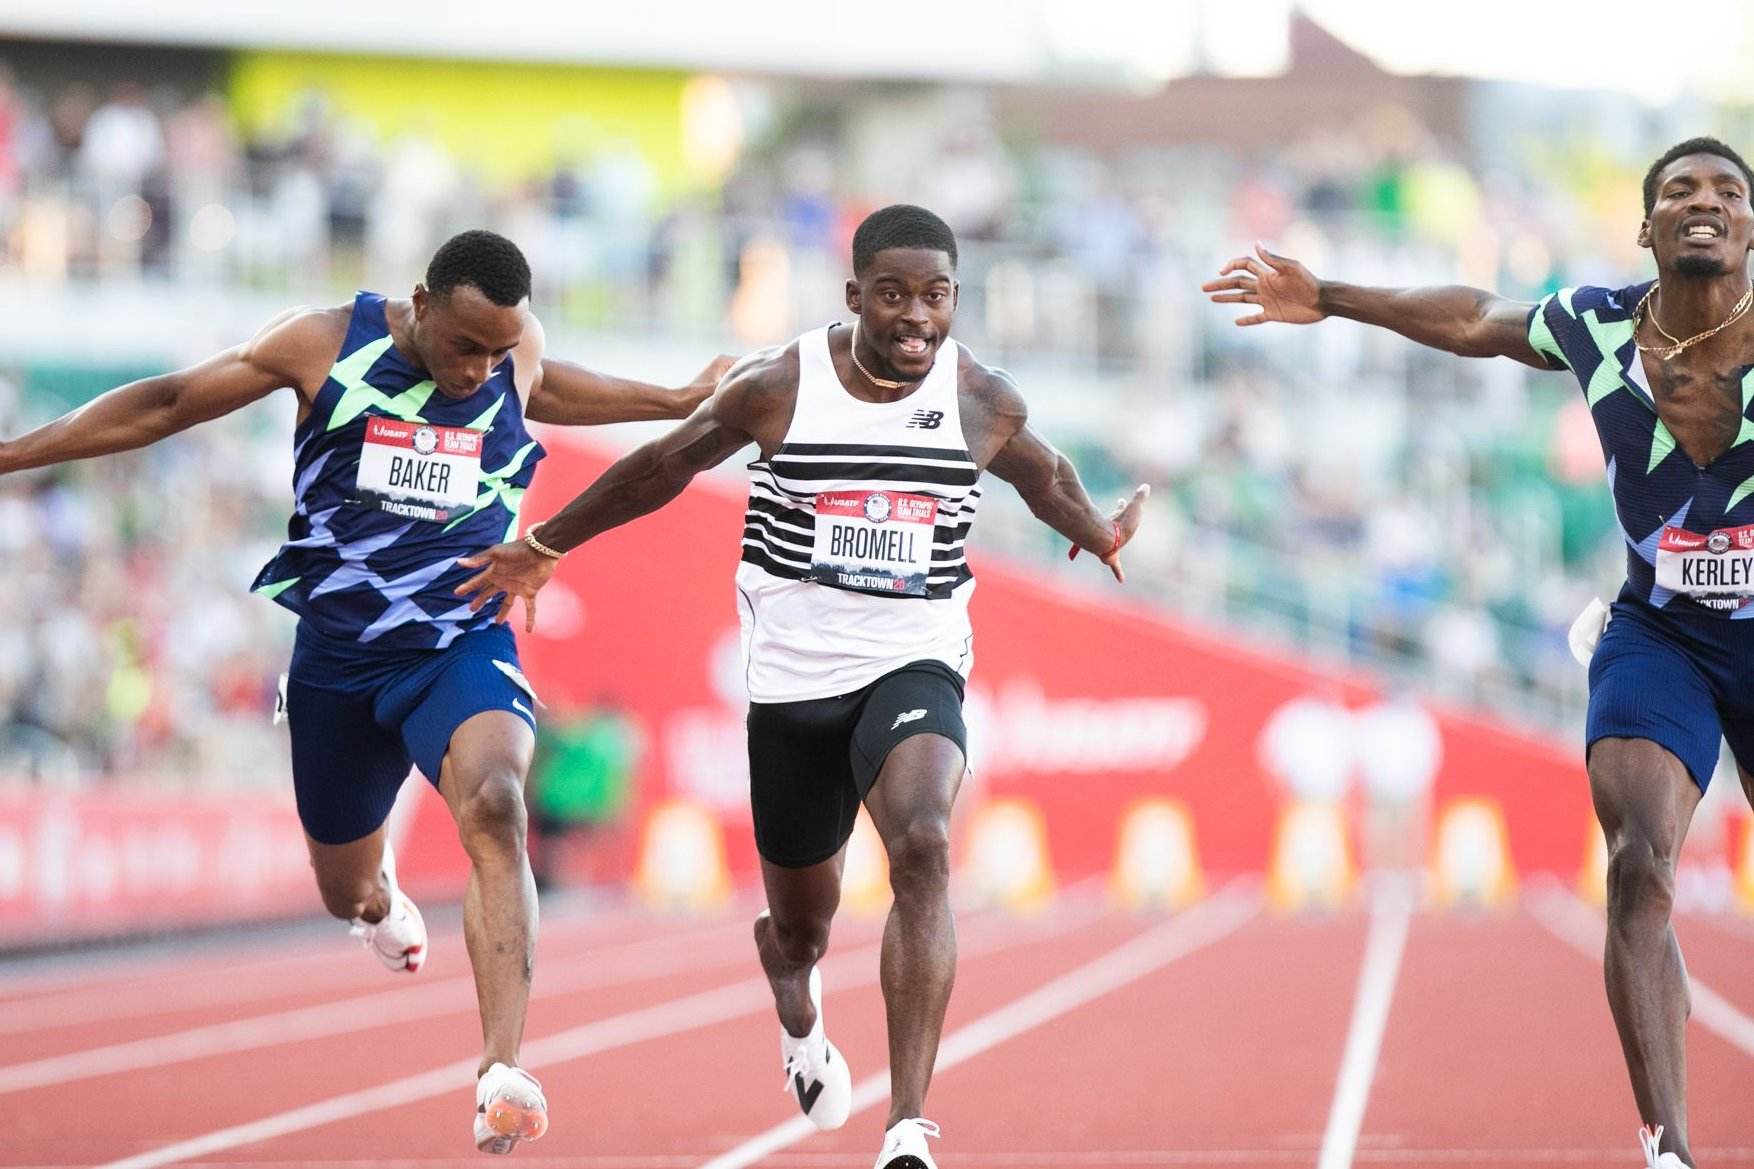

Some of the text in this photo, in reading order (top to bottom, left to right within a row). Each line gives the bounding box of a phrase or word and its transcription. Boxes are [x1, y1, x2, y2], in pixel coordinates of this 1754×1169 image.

[388, 455, 451, 494] BAKER
[830, 524, 917, 564] BROMELL
[1682, 556, 1754, 587] KERLEY
